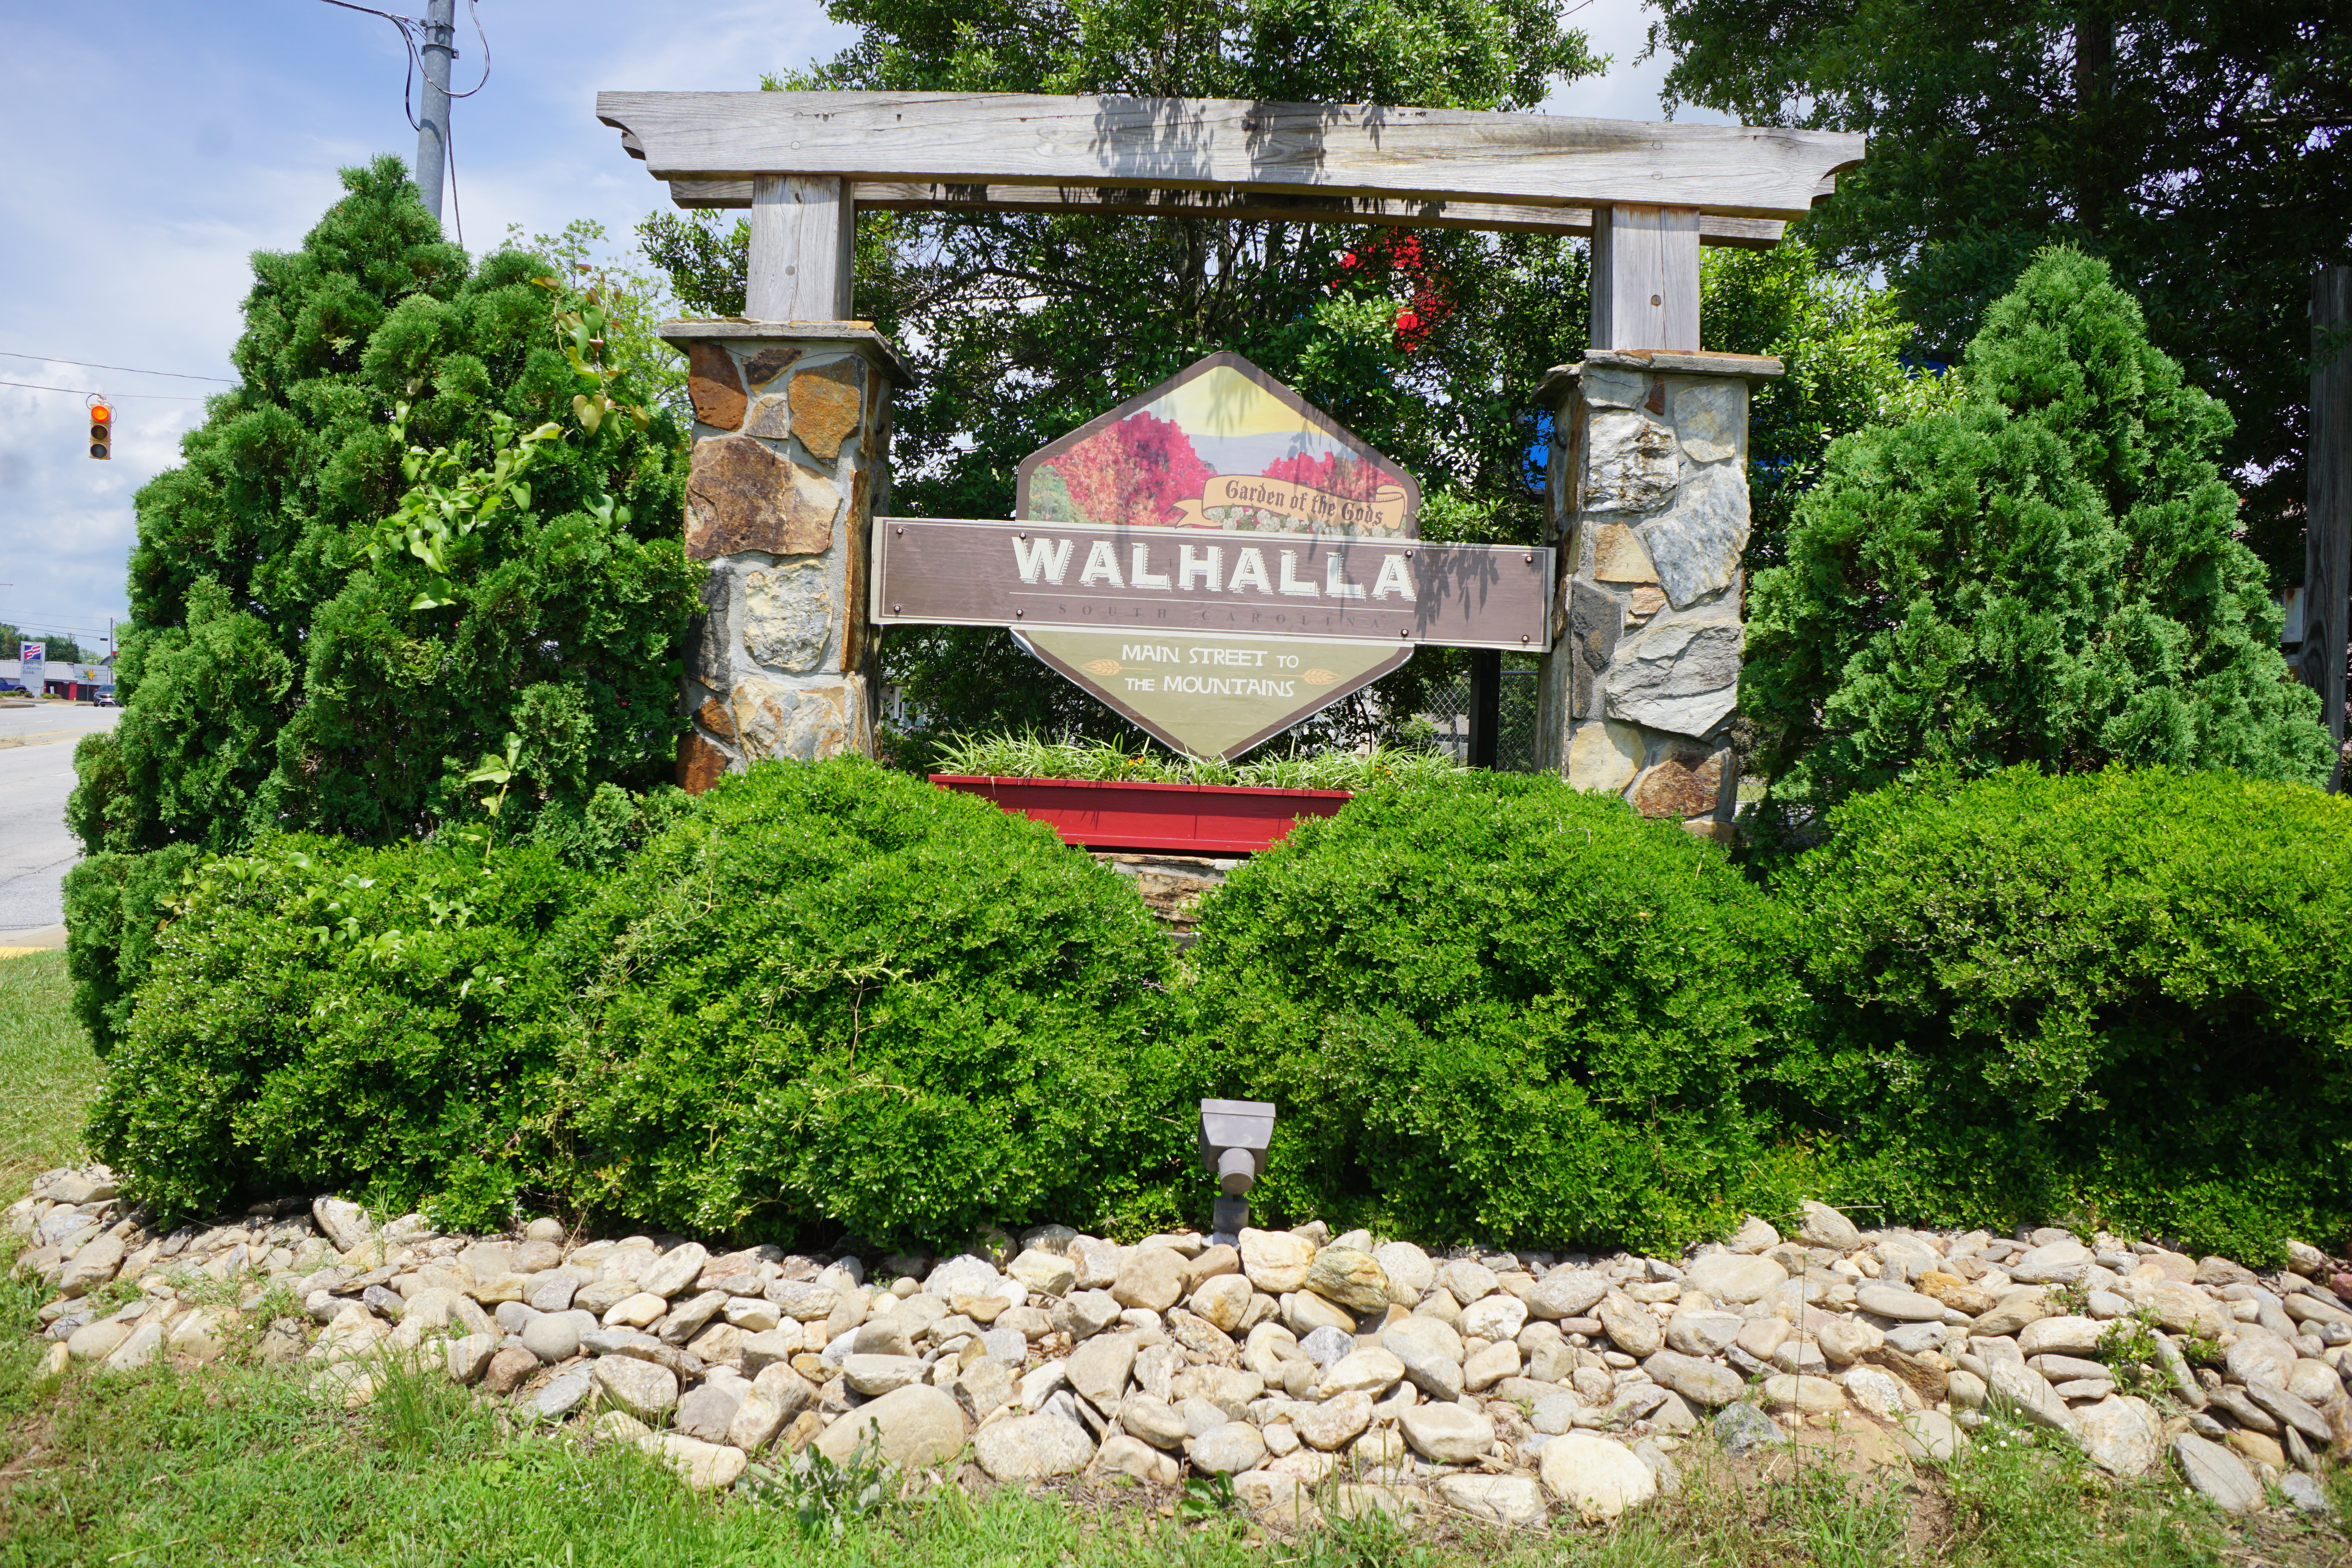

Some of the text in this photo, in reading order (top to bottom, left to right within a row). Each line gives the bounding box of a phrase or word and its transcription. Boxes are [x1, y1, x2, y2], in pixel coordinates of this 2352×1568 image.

[1225, 480, 1384, 526] Garden of the Gods
[1012, 537, 1417, 601] WALHALLA
[1059, 604, 1379, 628] SOUTH CAROLINA
[1122, 644, 1299, 668] MAIN STREET TO
[1125, 676, 1295, 697] THE MOUNTAINS
